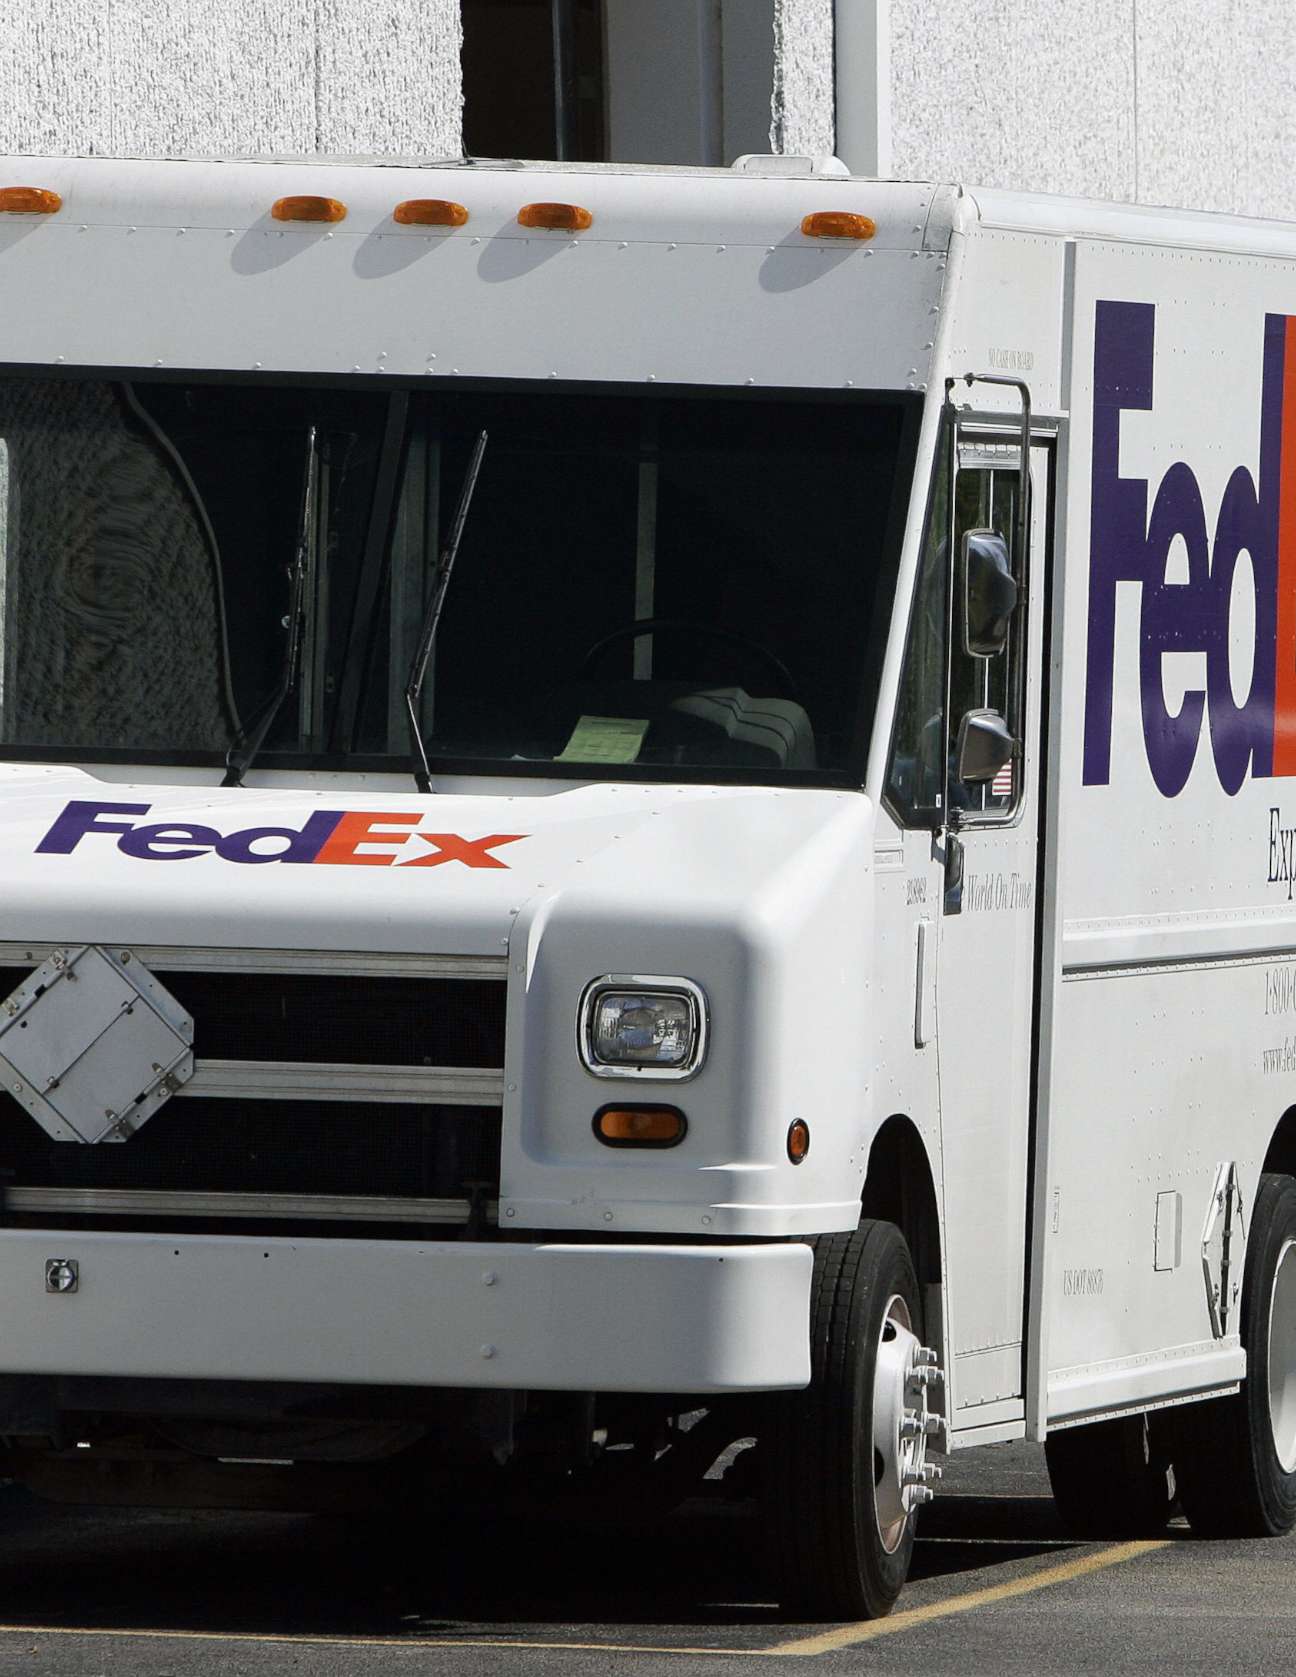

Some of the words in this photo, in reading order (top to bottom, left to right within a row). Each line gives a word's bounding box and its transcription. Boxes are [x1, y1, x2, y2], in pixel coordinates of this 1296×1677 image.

[34, 800, 534, 869] FedEx
[967, 873, 995, 912] World
[995, 873, 1008, 911] On
[1010, 872, 1032, 910] Time
